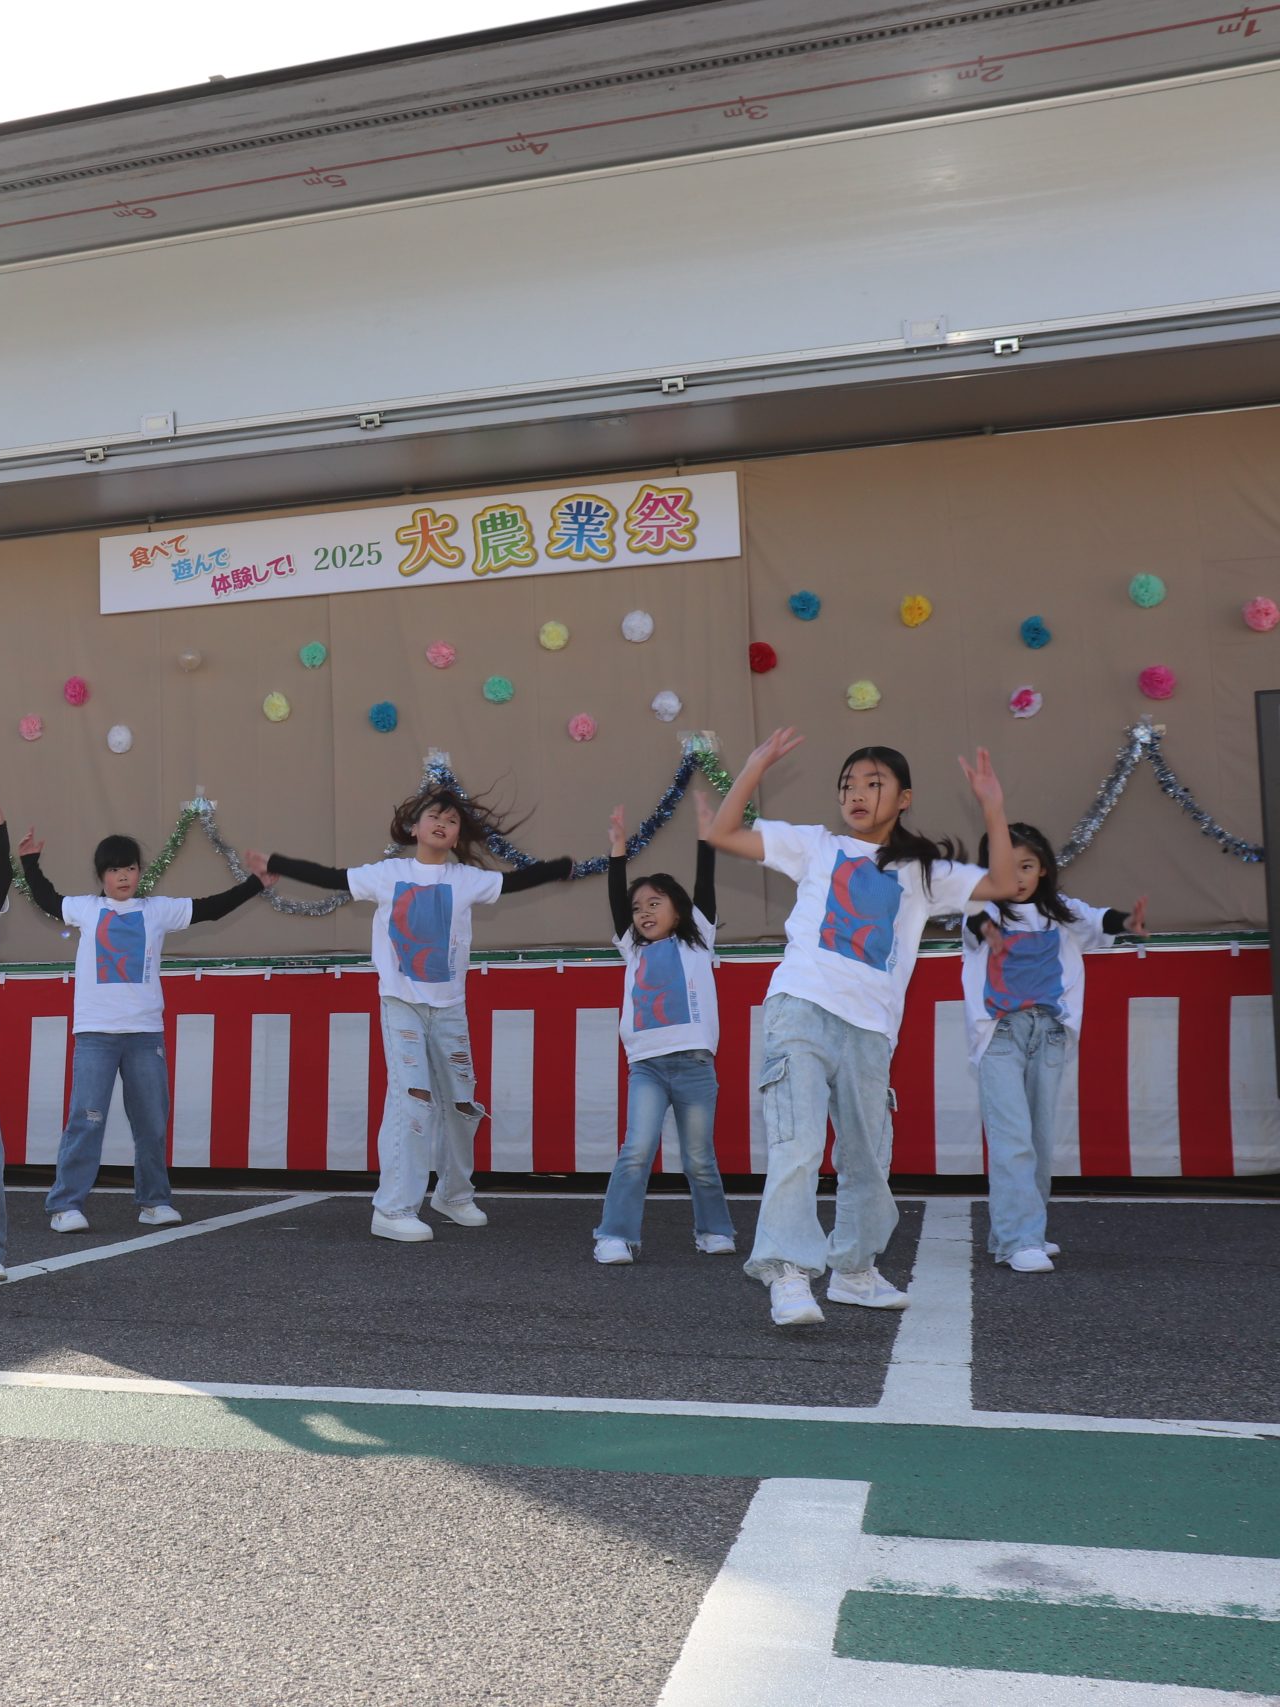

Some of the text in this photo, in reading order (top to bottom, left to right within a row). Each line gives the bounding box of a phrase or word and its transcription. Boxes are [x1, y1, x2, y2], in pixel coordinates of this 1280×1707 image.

[1217, 19, 1261, 37] 1m
[957, 65, 1004, 82] 2m
[723, 104, 768, 120] 3m
[505, 142, 549, 155] 4m
[303, 174, 347, 188] 5m
[112, 207, 156, 219] 6m
[314, 484, 698, 576] 2025 大農業祭
[129, 534, 188, 569] 食べて
[171, 547, 229, 582] 遊んで
[210, 554, 295, 596] 体験して!
